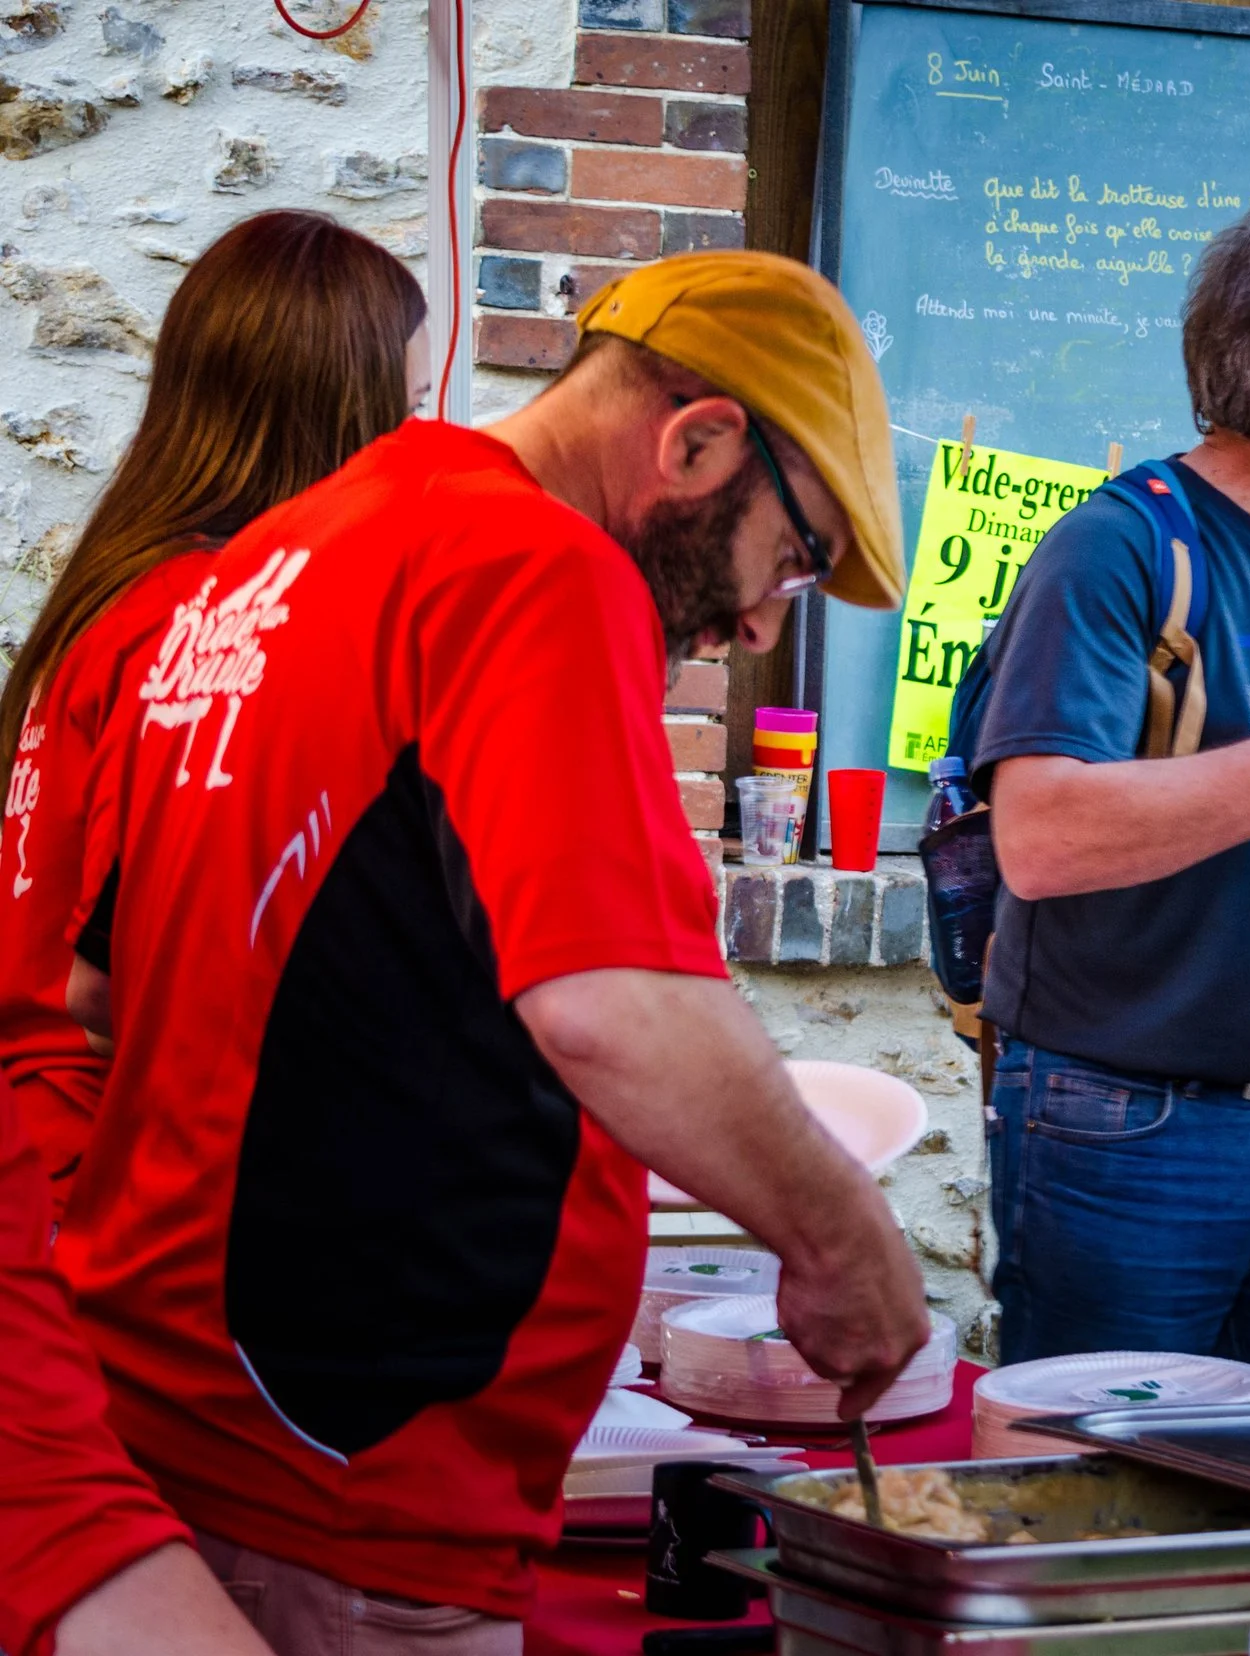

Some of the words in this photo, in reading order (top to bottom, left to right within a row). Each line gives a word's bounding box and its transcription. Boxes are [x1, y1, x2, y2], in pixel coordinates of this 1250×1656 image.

[928, 52, 943, 86] 8
[953, 60, 1000, 87] Juin
[1041, 62, 1090, 90] Saint
[1117, 70, 1194, 97] MÉDARD
[874, 166, 956, 192] Devinette
[1030, 176, 1060, 200] dit
[1068, 175, 1089, 202] la
[1097, 182, 1188, 209] trotteuse
[1197, 180, 1241, 209] d'une
[985, 214, 1000, 234] à
[1003, 208, 1059, 244] chaque
[1065, 213, 1099, 245] fois
[1105, 217, 1162, 249] qu'elle
[1168, 227, 1213, 242] croise
[985, 241, 1007, 266] la
[1018, 247, 1082, 279] grande
[1096, 250, 1175, 286] aiguille
[1183, 253, 1192, 277] ?
[916, 293, 975, 320] Attends
[1028, 308, 1058, 322] une
[1135, 312, 1151, 339] je
[933, 534, 972, 586] 9
